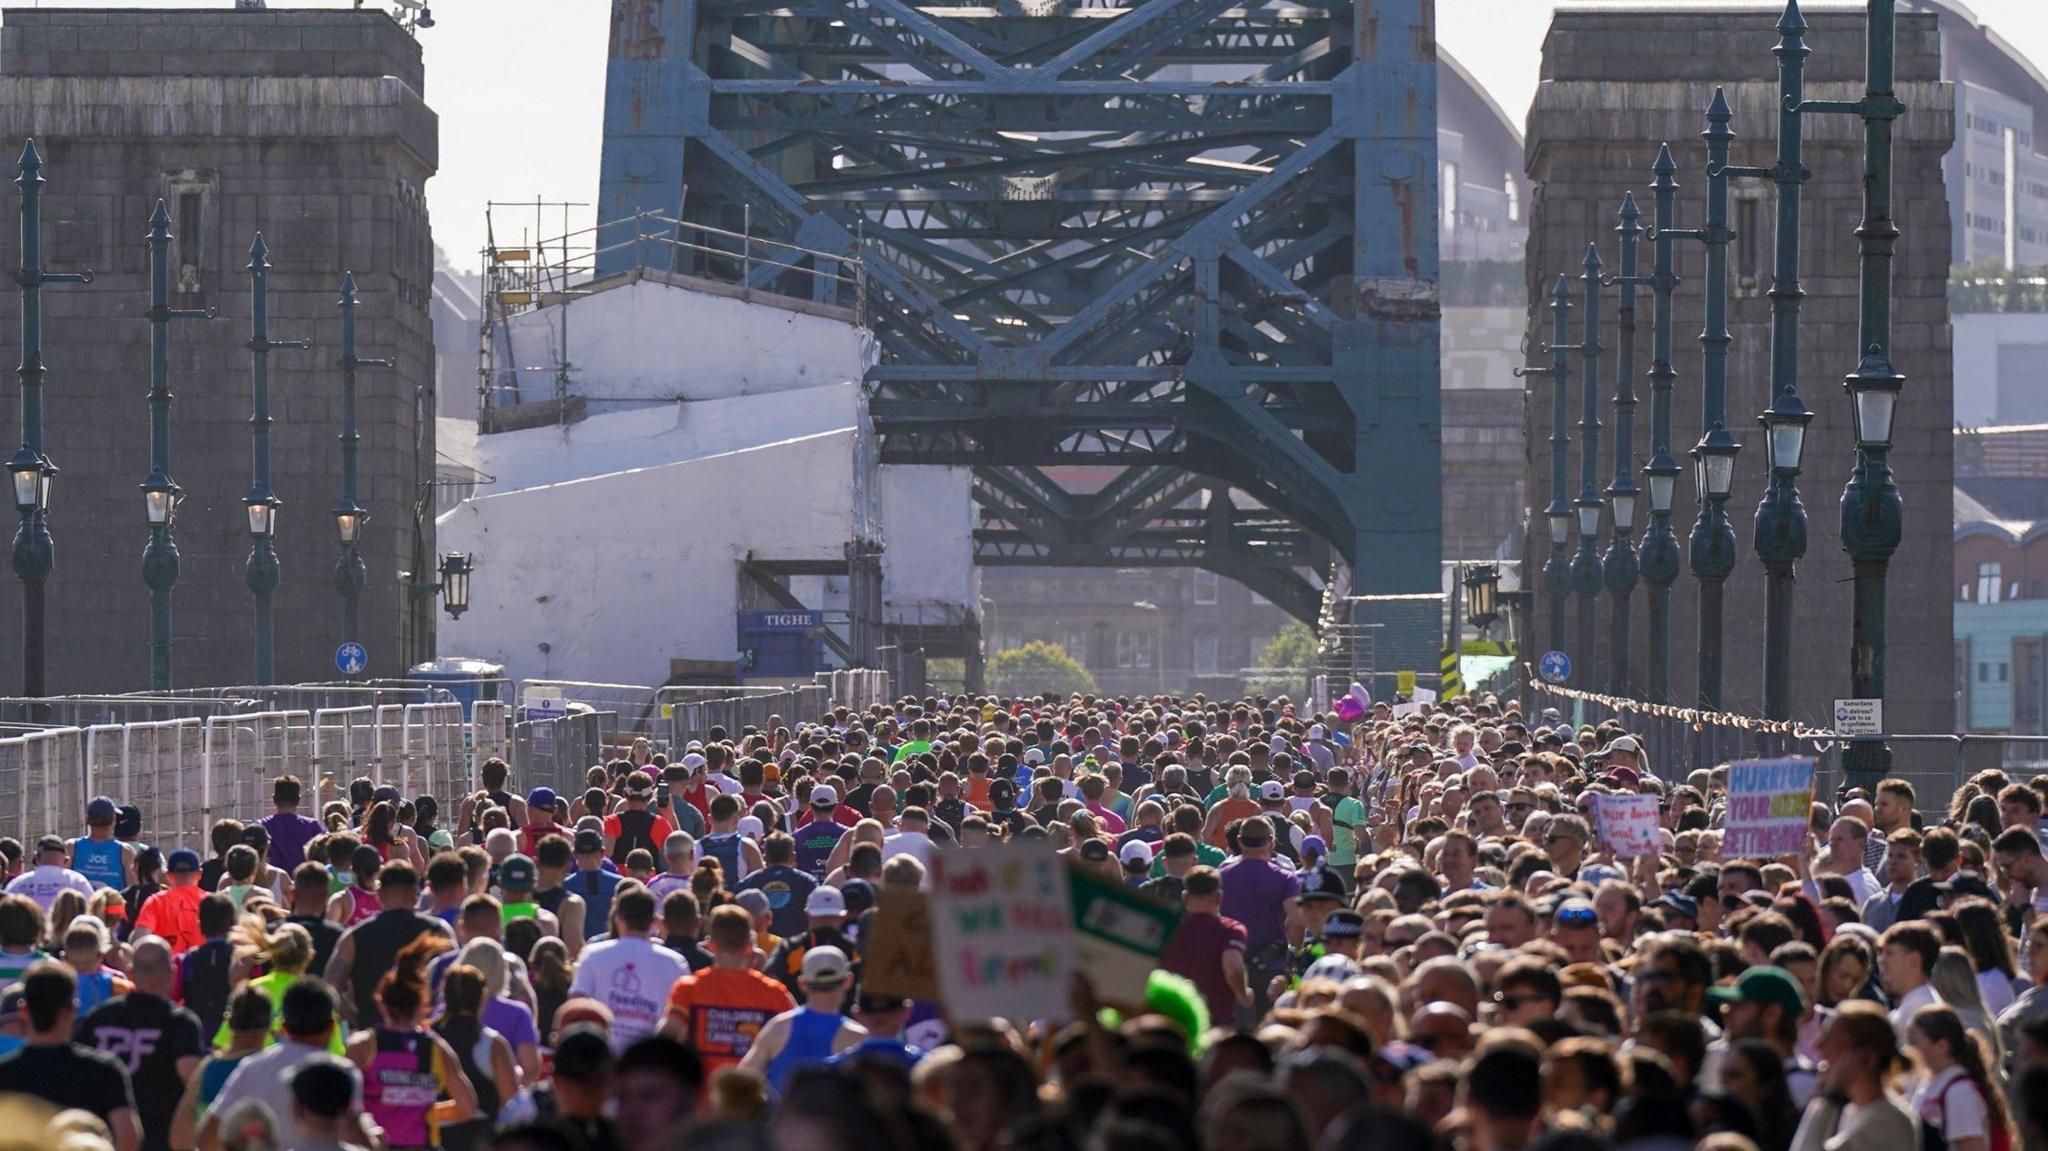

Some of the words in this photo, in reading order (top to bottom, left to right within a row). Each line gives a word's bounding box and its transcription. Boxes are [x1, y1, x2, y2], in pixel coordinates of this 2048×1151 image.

[765, 614, 812, 626] TIGHE
[1731, 763, 1788, 793] HURRY
[1730, 796, 1769, 821] YOUR
[88, 854, 109, 864] JOE
